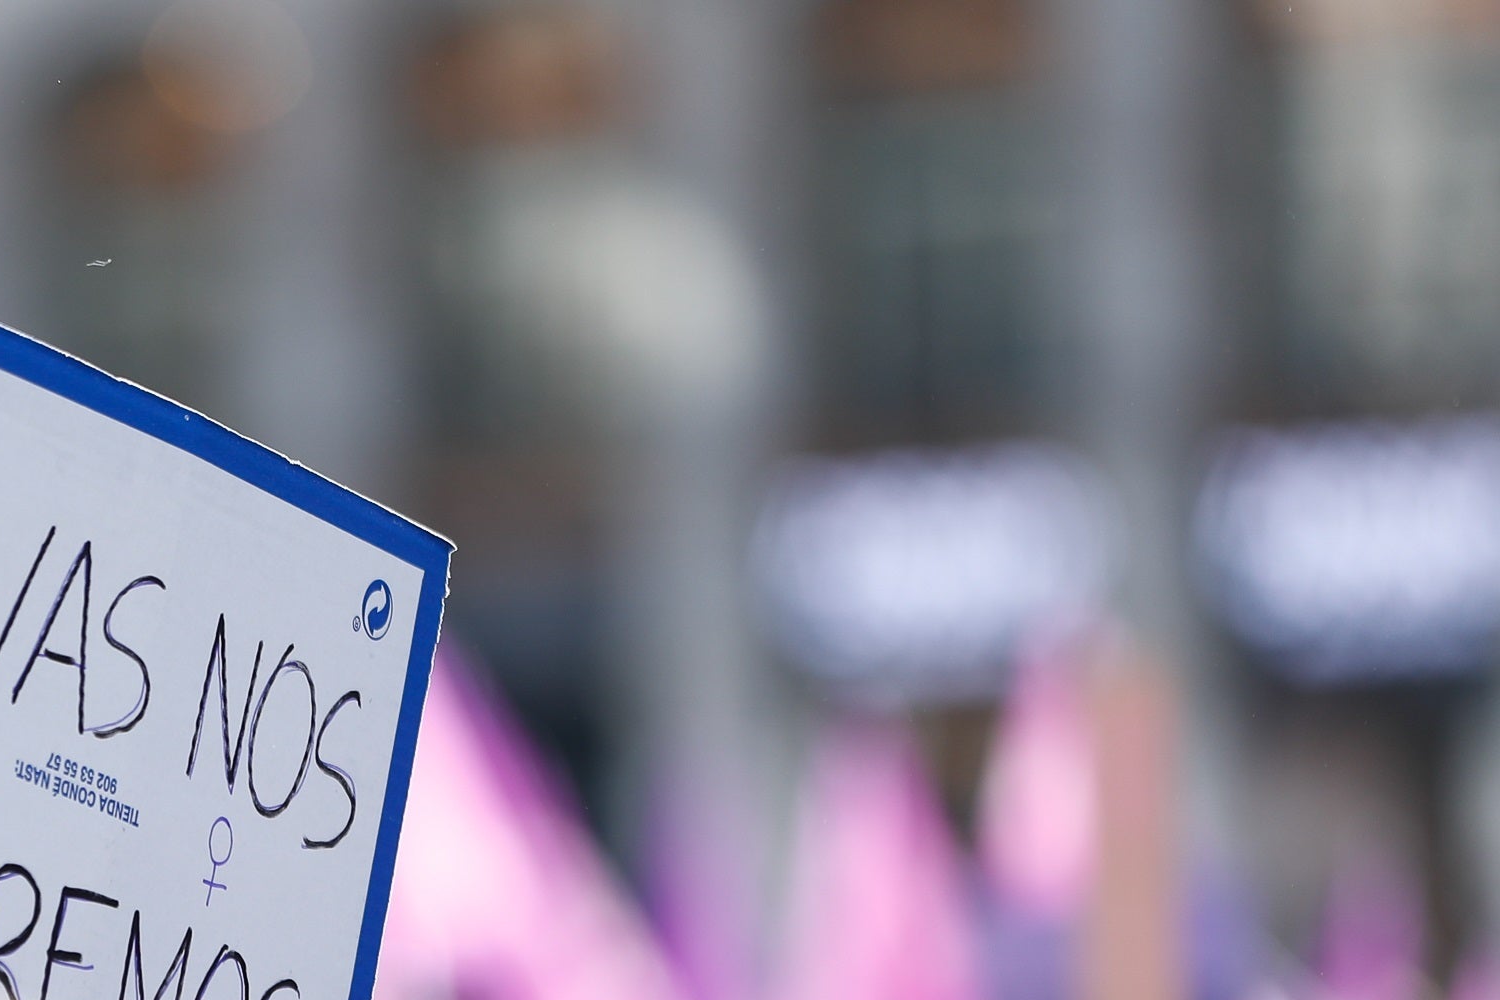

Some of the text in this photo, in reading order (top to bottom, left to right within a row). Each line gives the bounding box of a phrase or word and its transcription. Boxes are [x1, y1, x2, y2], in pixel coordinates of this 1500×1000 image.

[186, 613, 362, 849] NOS
[14, 759, 139, 828] TIENDA CONDÉ NAST:
[46, 753, 118, 795] 902 53 55 57
